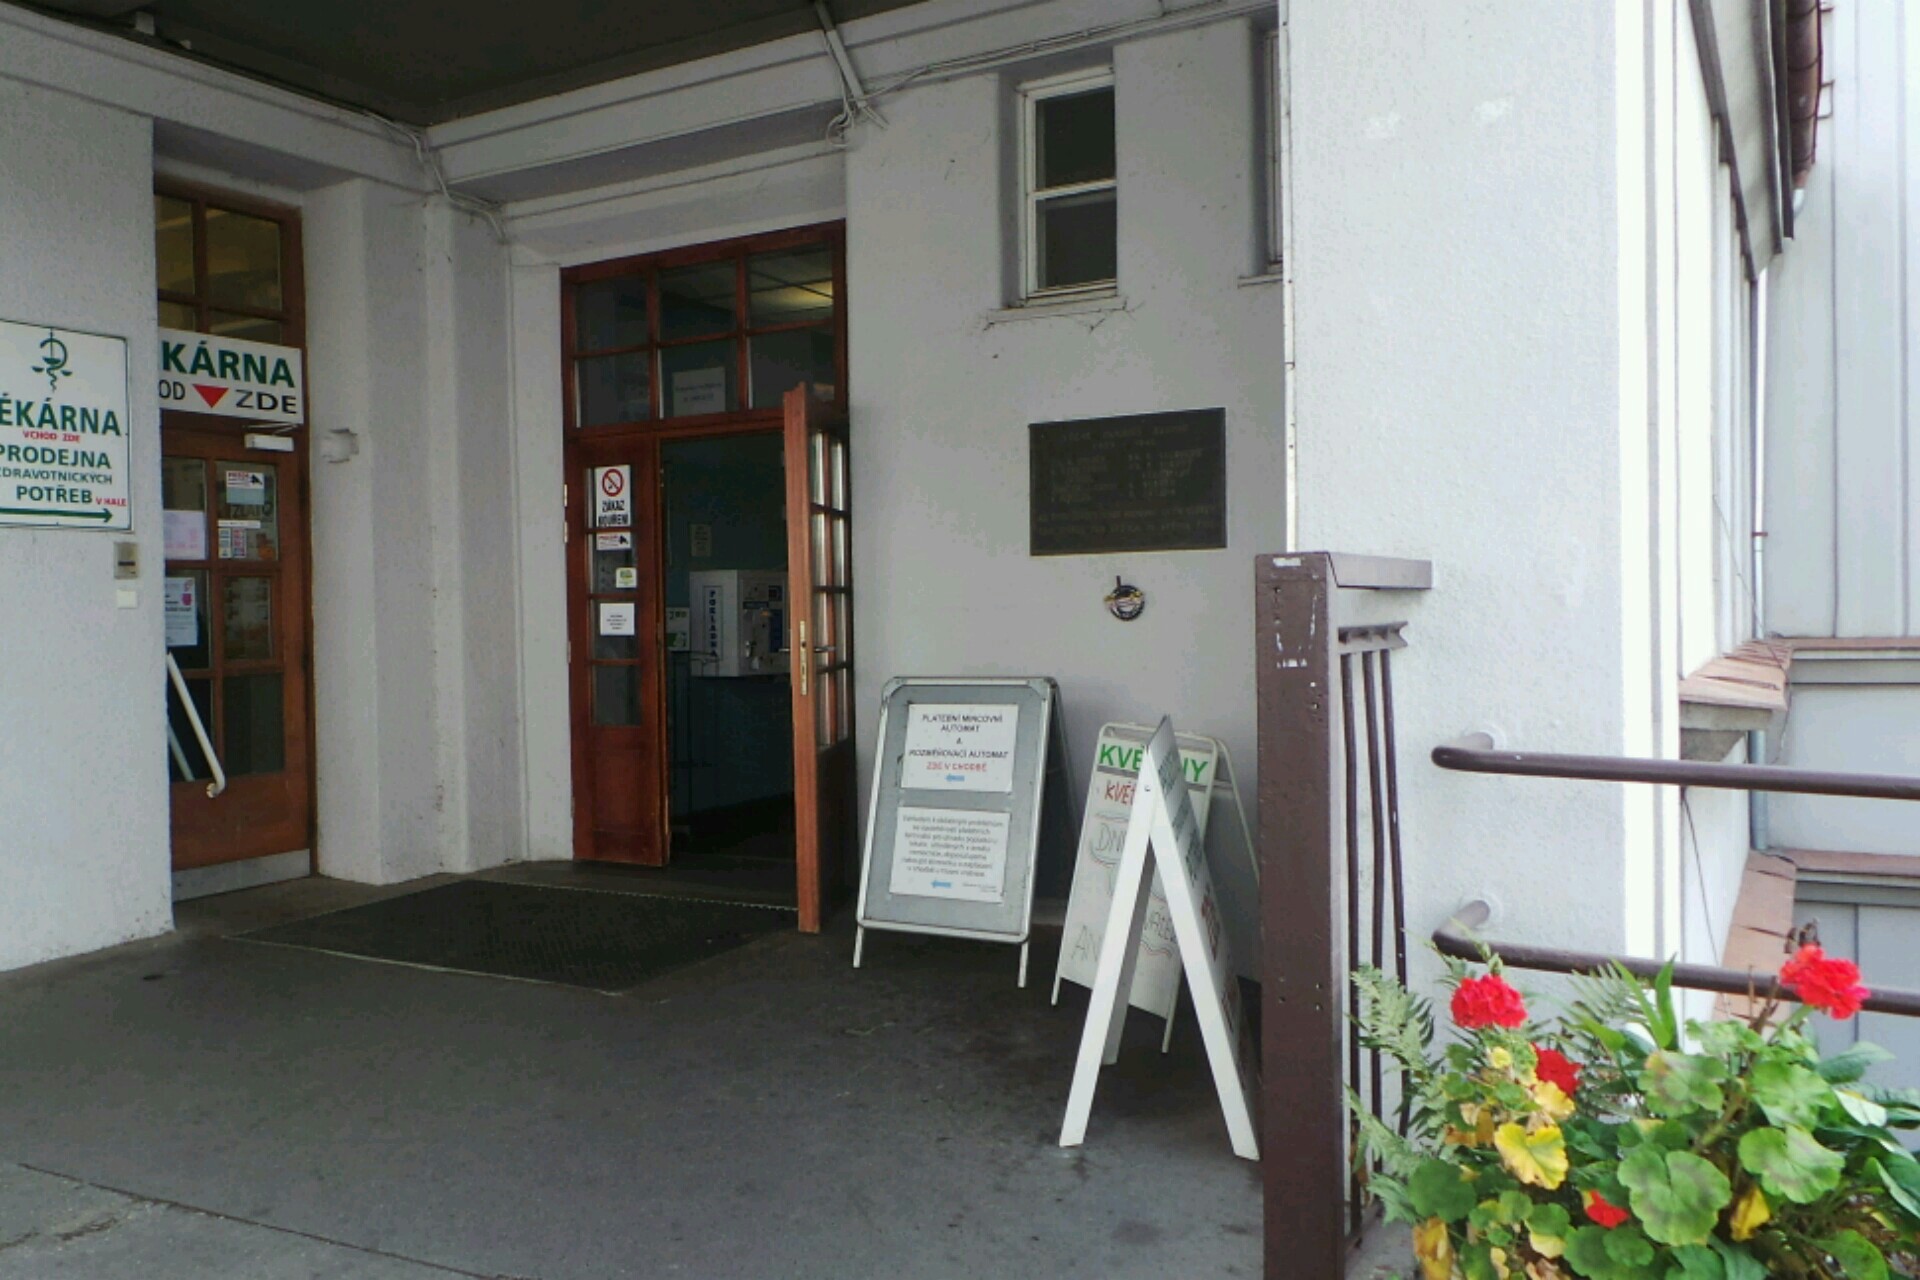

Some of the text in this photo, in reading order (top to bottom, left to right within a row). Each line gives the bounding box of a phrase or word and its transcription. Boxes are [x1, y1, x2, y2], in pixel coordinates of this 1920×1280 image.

[161, 340, 295, 388] KÁRNA
[158, 379, 297, 414] OD ZDE
[22, 430, 81, 443] VCHOD ZDE
[0, 467, 112, 485] DRAVOTNICKÝCH
[16, 484, 93, 504] POTŘEB
[95, 497, 103, 506] V
